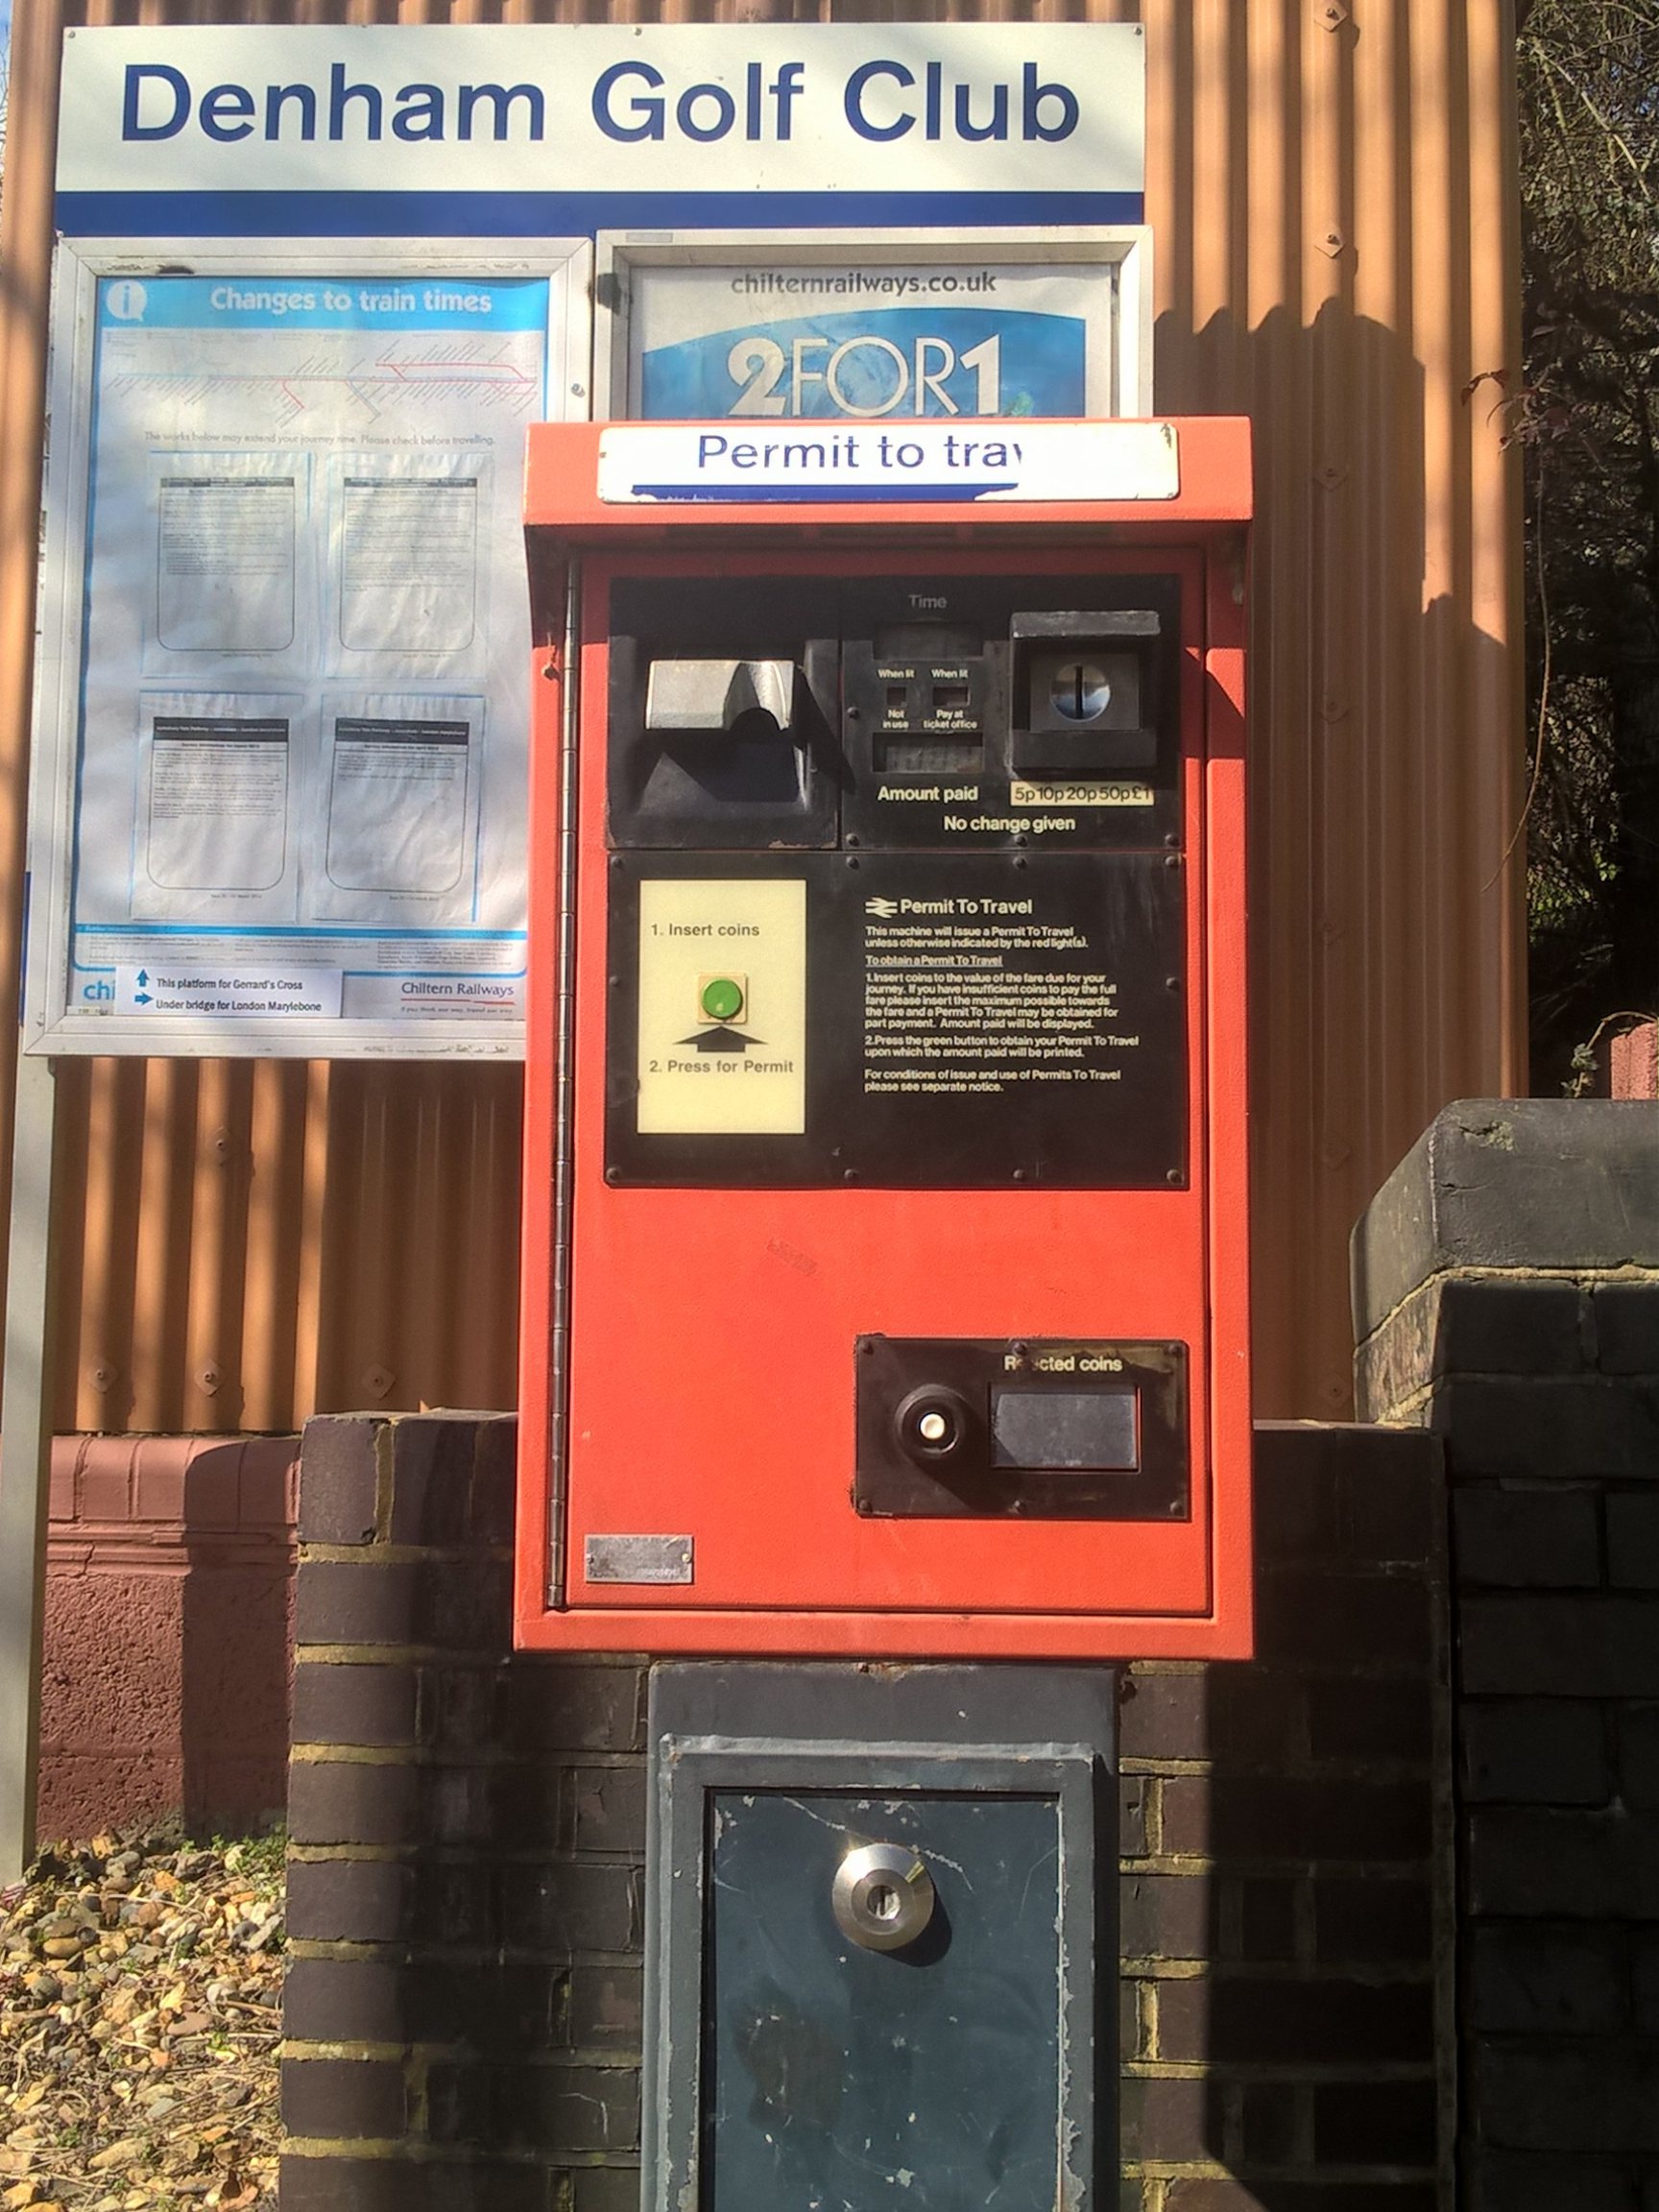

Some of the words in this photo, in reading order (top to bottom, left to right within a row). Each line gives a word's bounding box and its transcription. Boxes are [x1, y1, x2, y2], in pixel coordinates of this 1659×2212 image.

[121, 62, 545, 141] Denham
[590, 60, 805, 143] Golf
[844, 60, 1080, 143] Club
[732, 272, 997, 296] chilternrailways.co.uk
[210, 287, 315, 315] Changes
[323, 290, 351, 311] to
[359, 287, 416, 312] train
[422, 288, 492, 313] times
[727, 333, 1000, 418] 2FOR1
[698, 435, 859, 469] Permit
[878, 435, 925, 469] to
[908, 594, 948, 609] Time
[878, 668, 904, 678] When
[905, 669, 915, 678] lit
[931, 668, 958, 678] When
[959, 669, 969, 678] lit
[887, 709, 904, 718] Not
[936, 709, 953, 720] Pay
[878, 785, 940, 801] Amount
[943, 785, 978, 803] paid
[1014, 787, 1035, 803] 5p
[1037, 786, 1064, 803] 10p
[1067, 786, 1097, 803] 20p
[1099, 785, 1130, 803] 50p
[1132, 785, 1149, 799] £1
[944, 816, 967, 830] No
[970, 816, 1032, 833] change
[1033, 816, 1075, 833] given
[901, 899, 954, 914] Permit
[956, 899, 979, 914] To
[979, 899, 1033, 914] Travel
[651, 924, 664, 937] 1.
[669, 924, 712, 936] Insert
[718, 924, 760, 936] coins
[156, 978, 175, 988] This
[177, 979, 216, 990] platform
[219, 979, 232, 989] for
[276, 980, 302, 990] Cross
[401, 982, 453, 995] Chiltern
[457, 983, 515, 998] Railways
[156, 999, 184, 1008] Under
[186, 999, 215, 1012] bridge
[217, 1000, 230, 1009] for
[232, 1000, 266, 1010] London
[649, 1060, 662, 1073] 2.
[667, 1060, 710, 1073] Press
[716, 1060, 737, 1073] for
[744, 1060, 793, 1073] Permit
[1004, 1356, 1075, 1371] Rcted
[1079, 1356, 1123, 1371] coins
